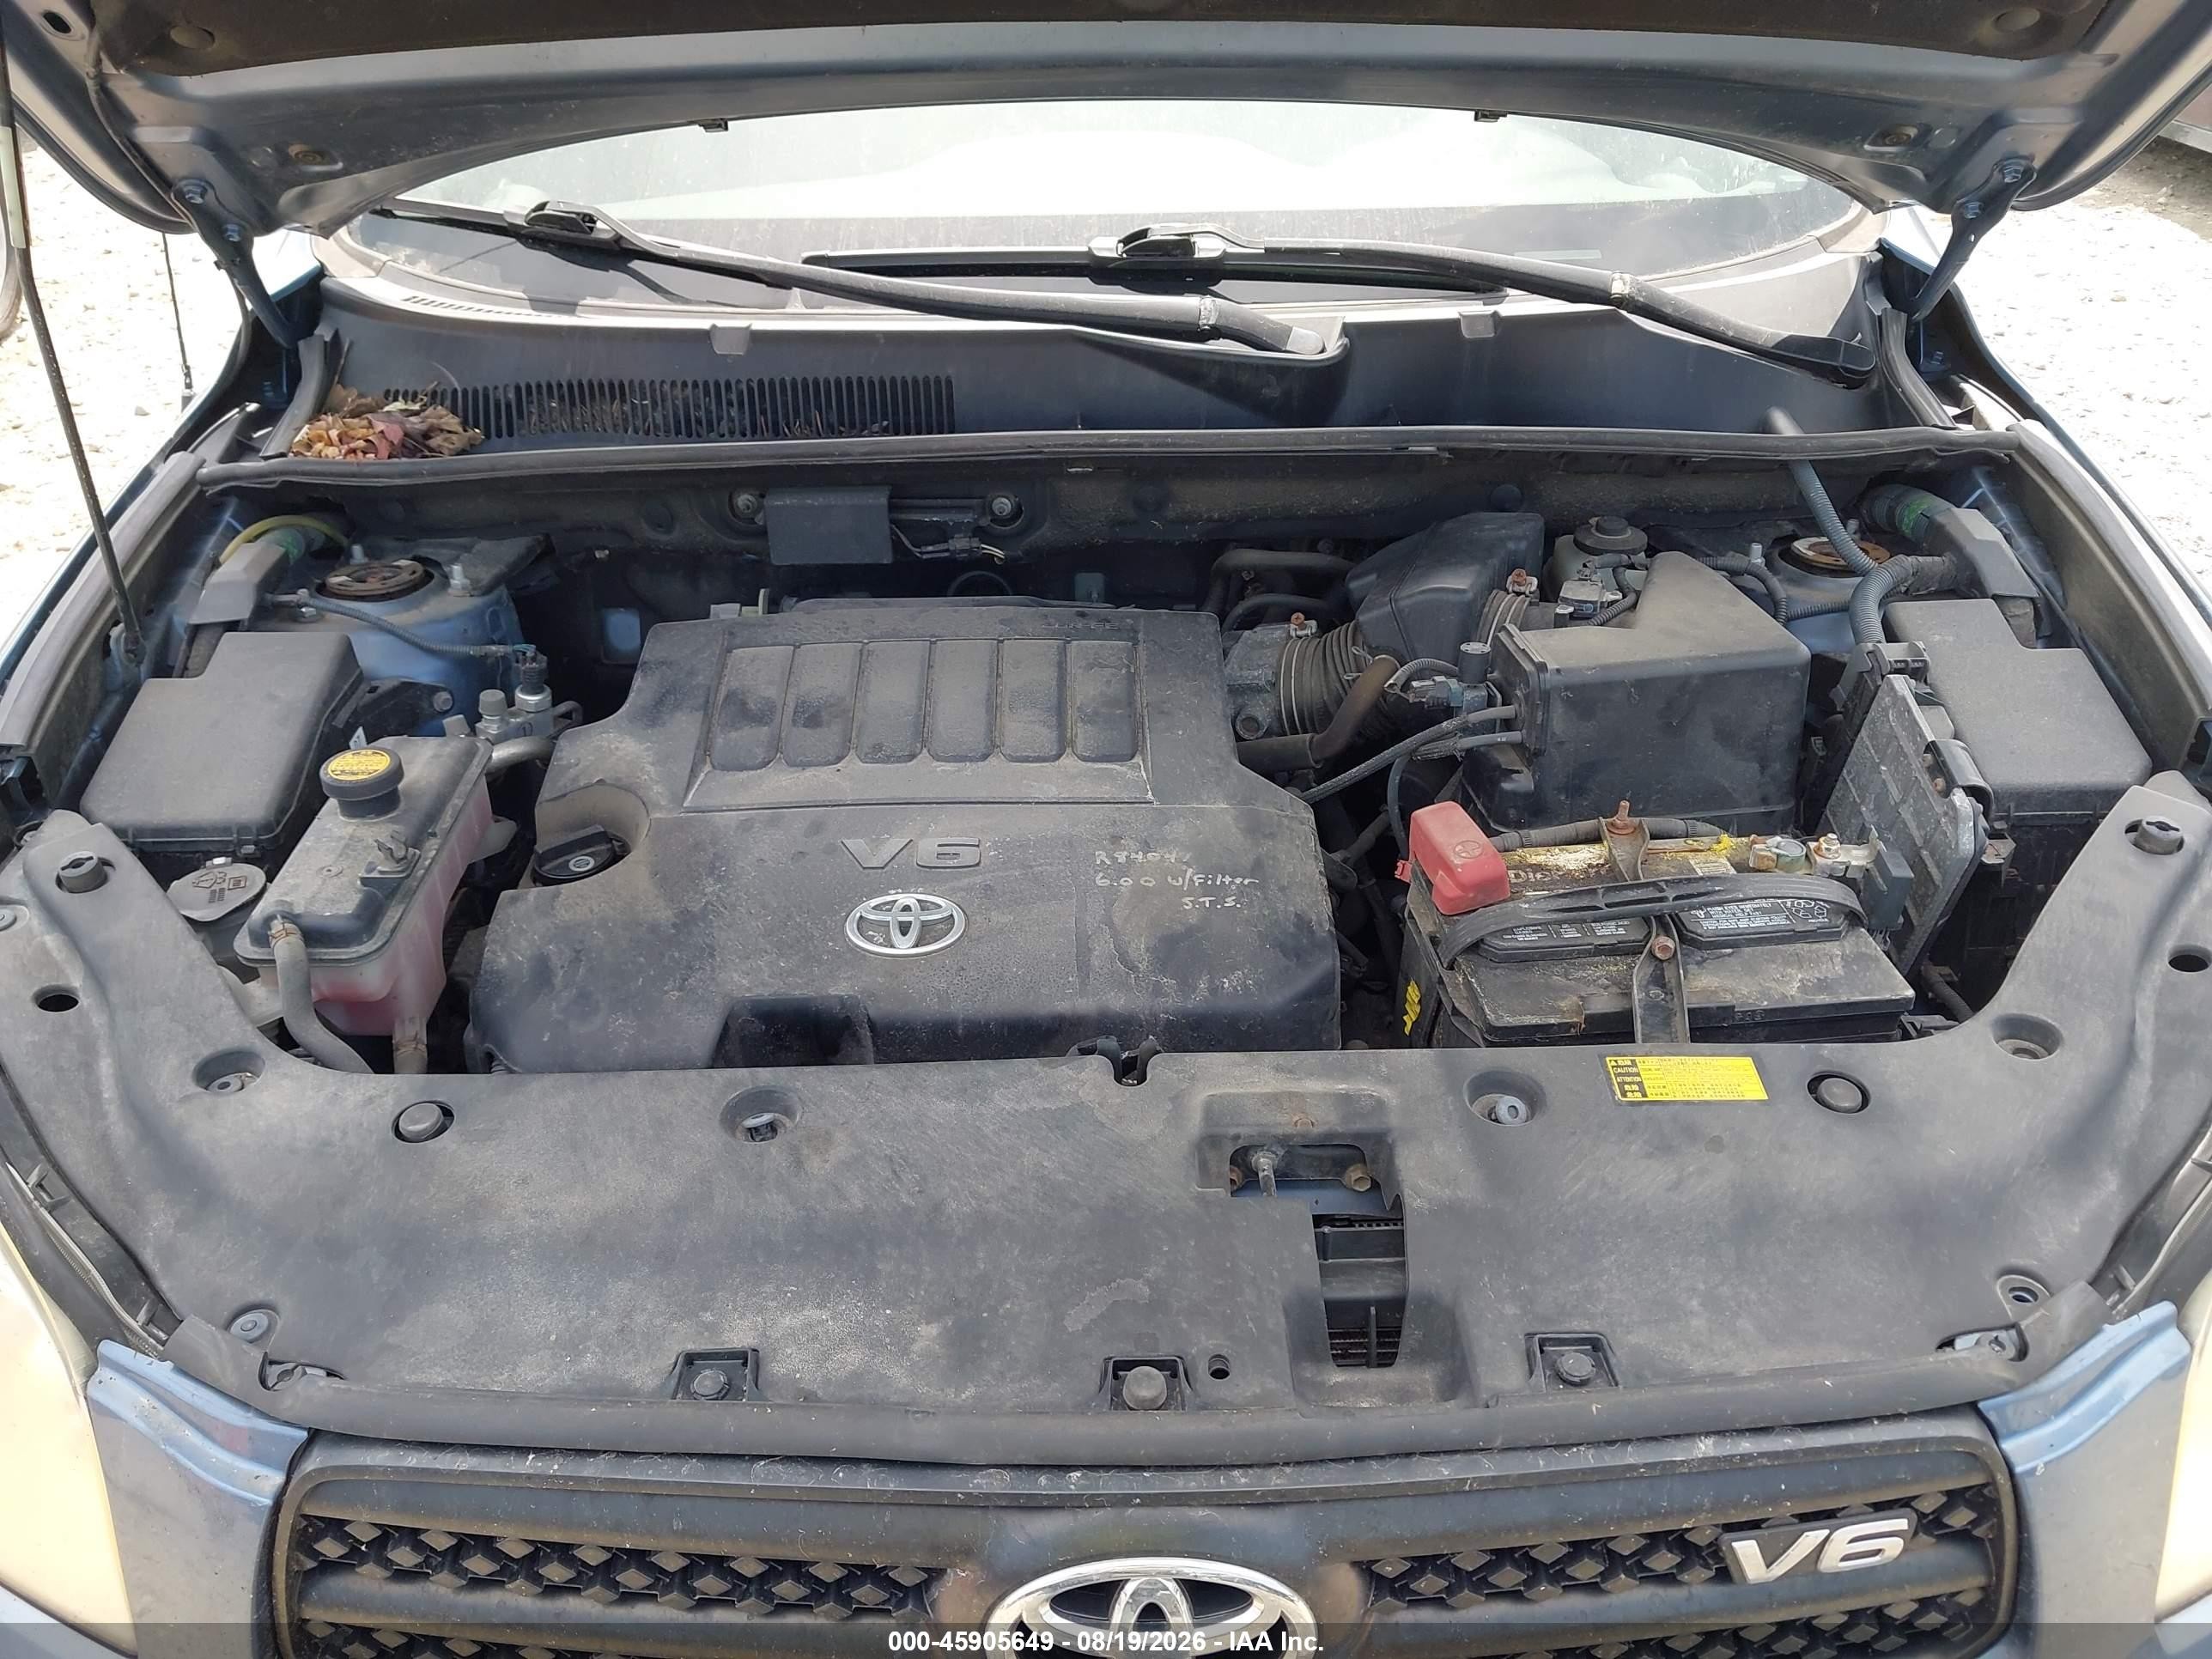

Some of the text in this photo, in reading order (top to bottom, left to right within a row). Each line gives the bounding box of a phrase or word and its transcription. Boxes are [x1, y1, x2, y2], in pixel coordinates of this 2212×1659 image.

[840, 838, 981, 870] V6
[1182, 896, 1242, 910] S.T.S.
[1731, 1517, 1909, 1584] V6
